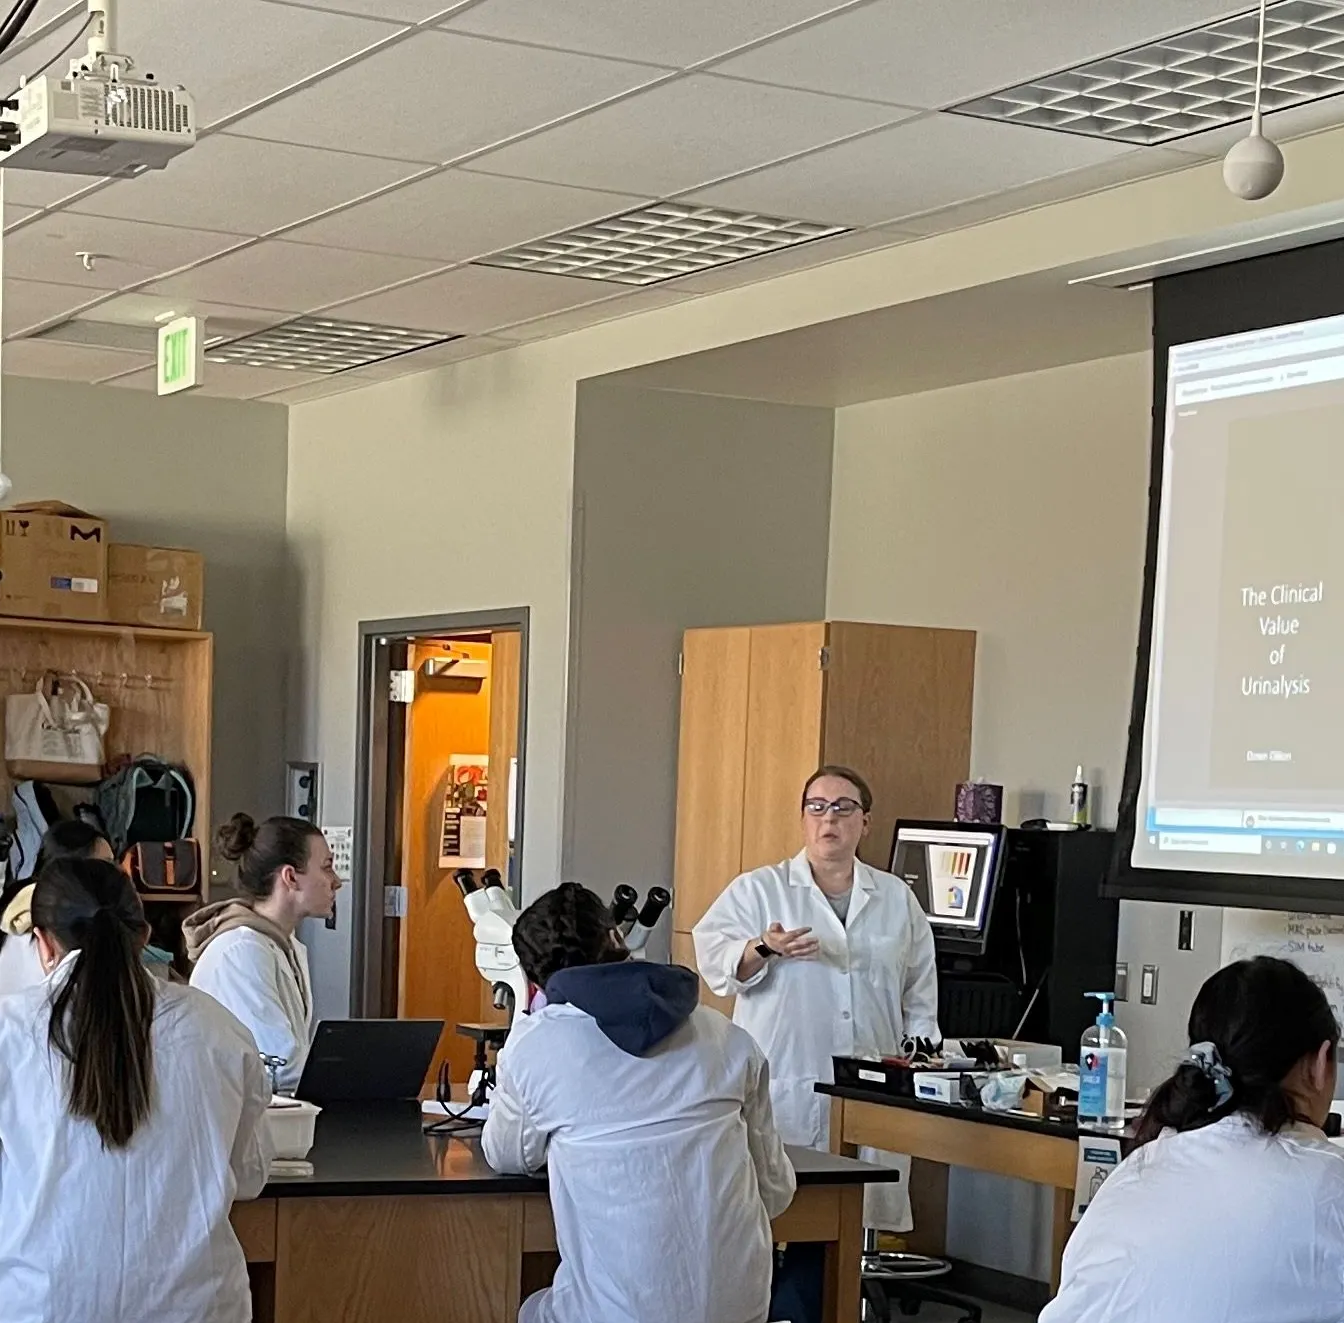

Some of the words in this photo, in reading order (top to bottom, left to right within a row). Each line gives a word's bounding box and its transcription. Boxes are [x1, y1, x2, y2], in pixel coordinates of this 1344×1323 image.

[164, 327, 189, 383] EXIT
[1241, 586, 1267, 608] The
[1270, 580, 1324, 605] Clinical
[1259, 614, 1300, 636] Value
[1269, 644, 1286, 665] of
[1241, 674, 1311, 699] Urinalysis
